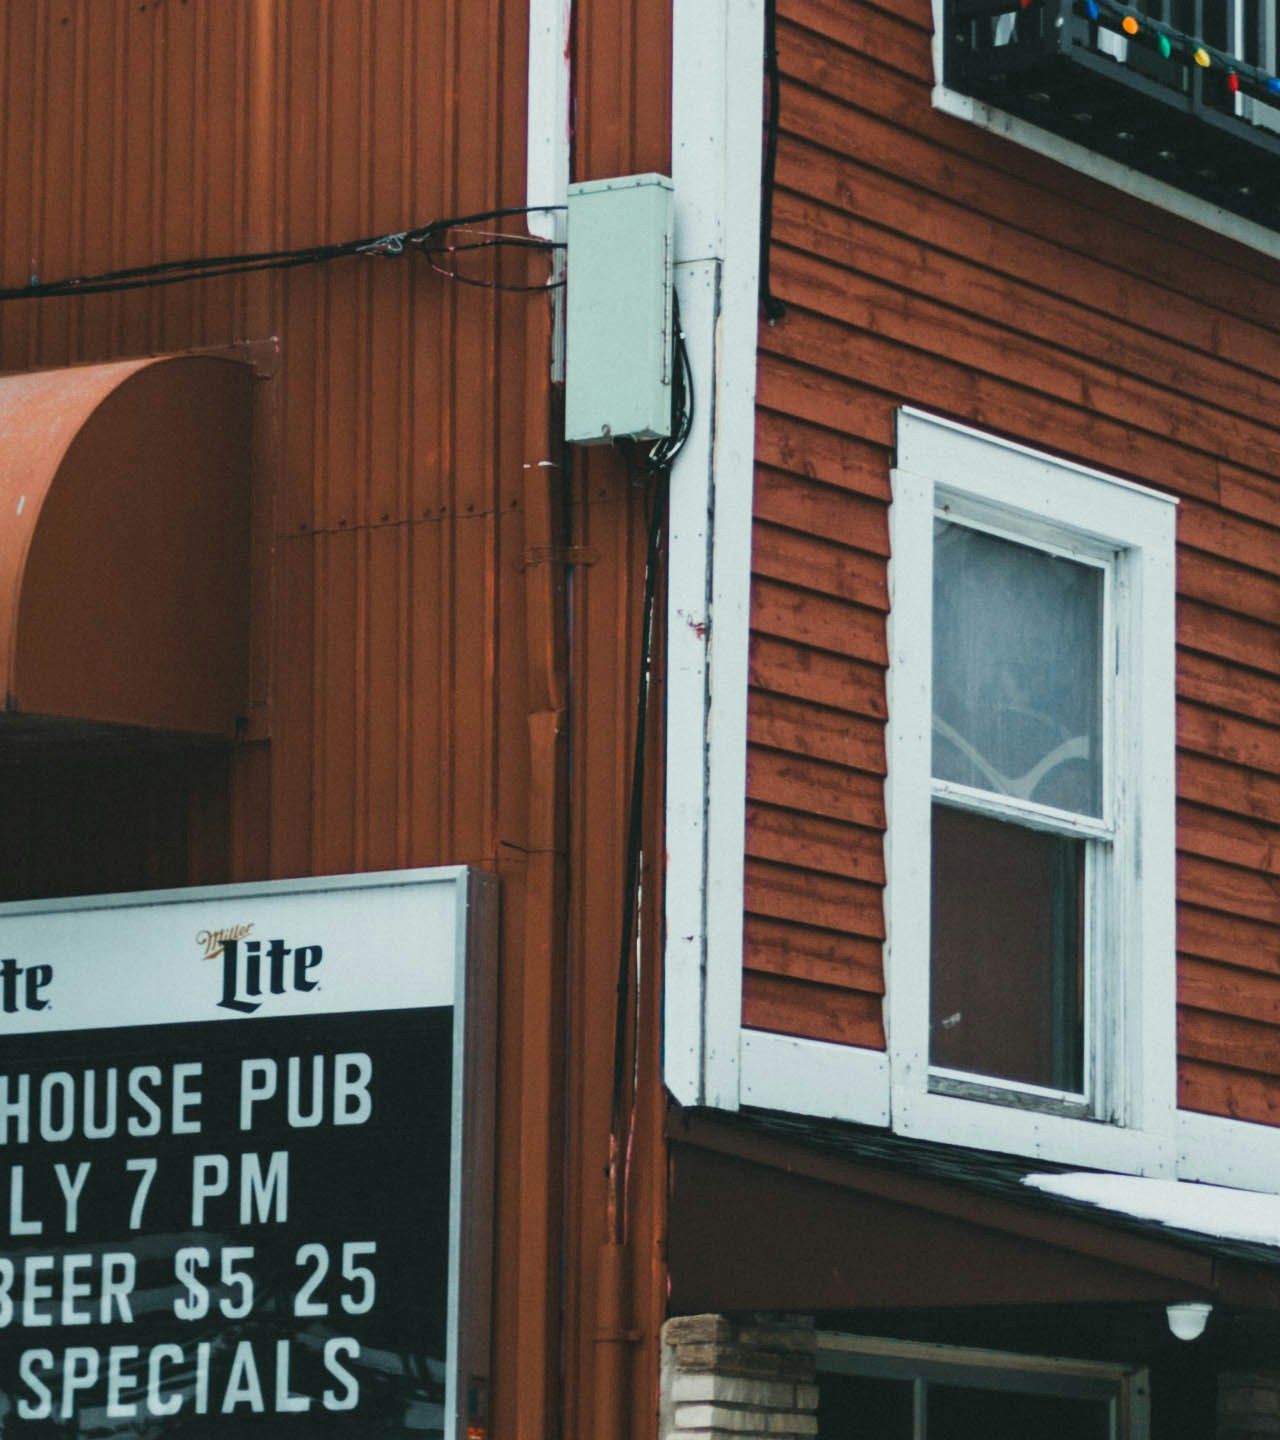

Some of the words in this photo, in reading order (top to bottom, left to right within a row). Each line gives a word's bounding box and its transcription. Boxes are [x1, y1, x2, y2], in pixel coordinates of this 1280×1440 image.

[195, 922, 256, 960] Miller
[215, 938, 324, 1014] Lite
[240, 1052, 373, 1131] PUB
[126, 1157, 158, 1230] 7
[191, 1150, 289, 1227] PM
[173, 1246, 254, 1321] $5
[294, 1241, 377, 1317] 25
[17, 1337, 361, 1420] SPECIALS
